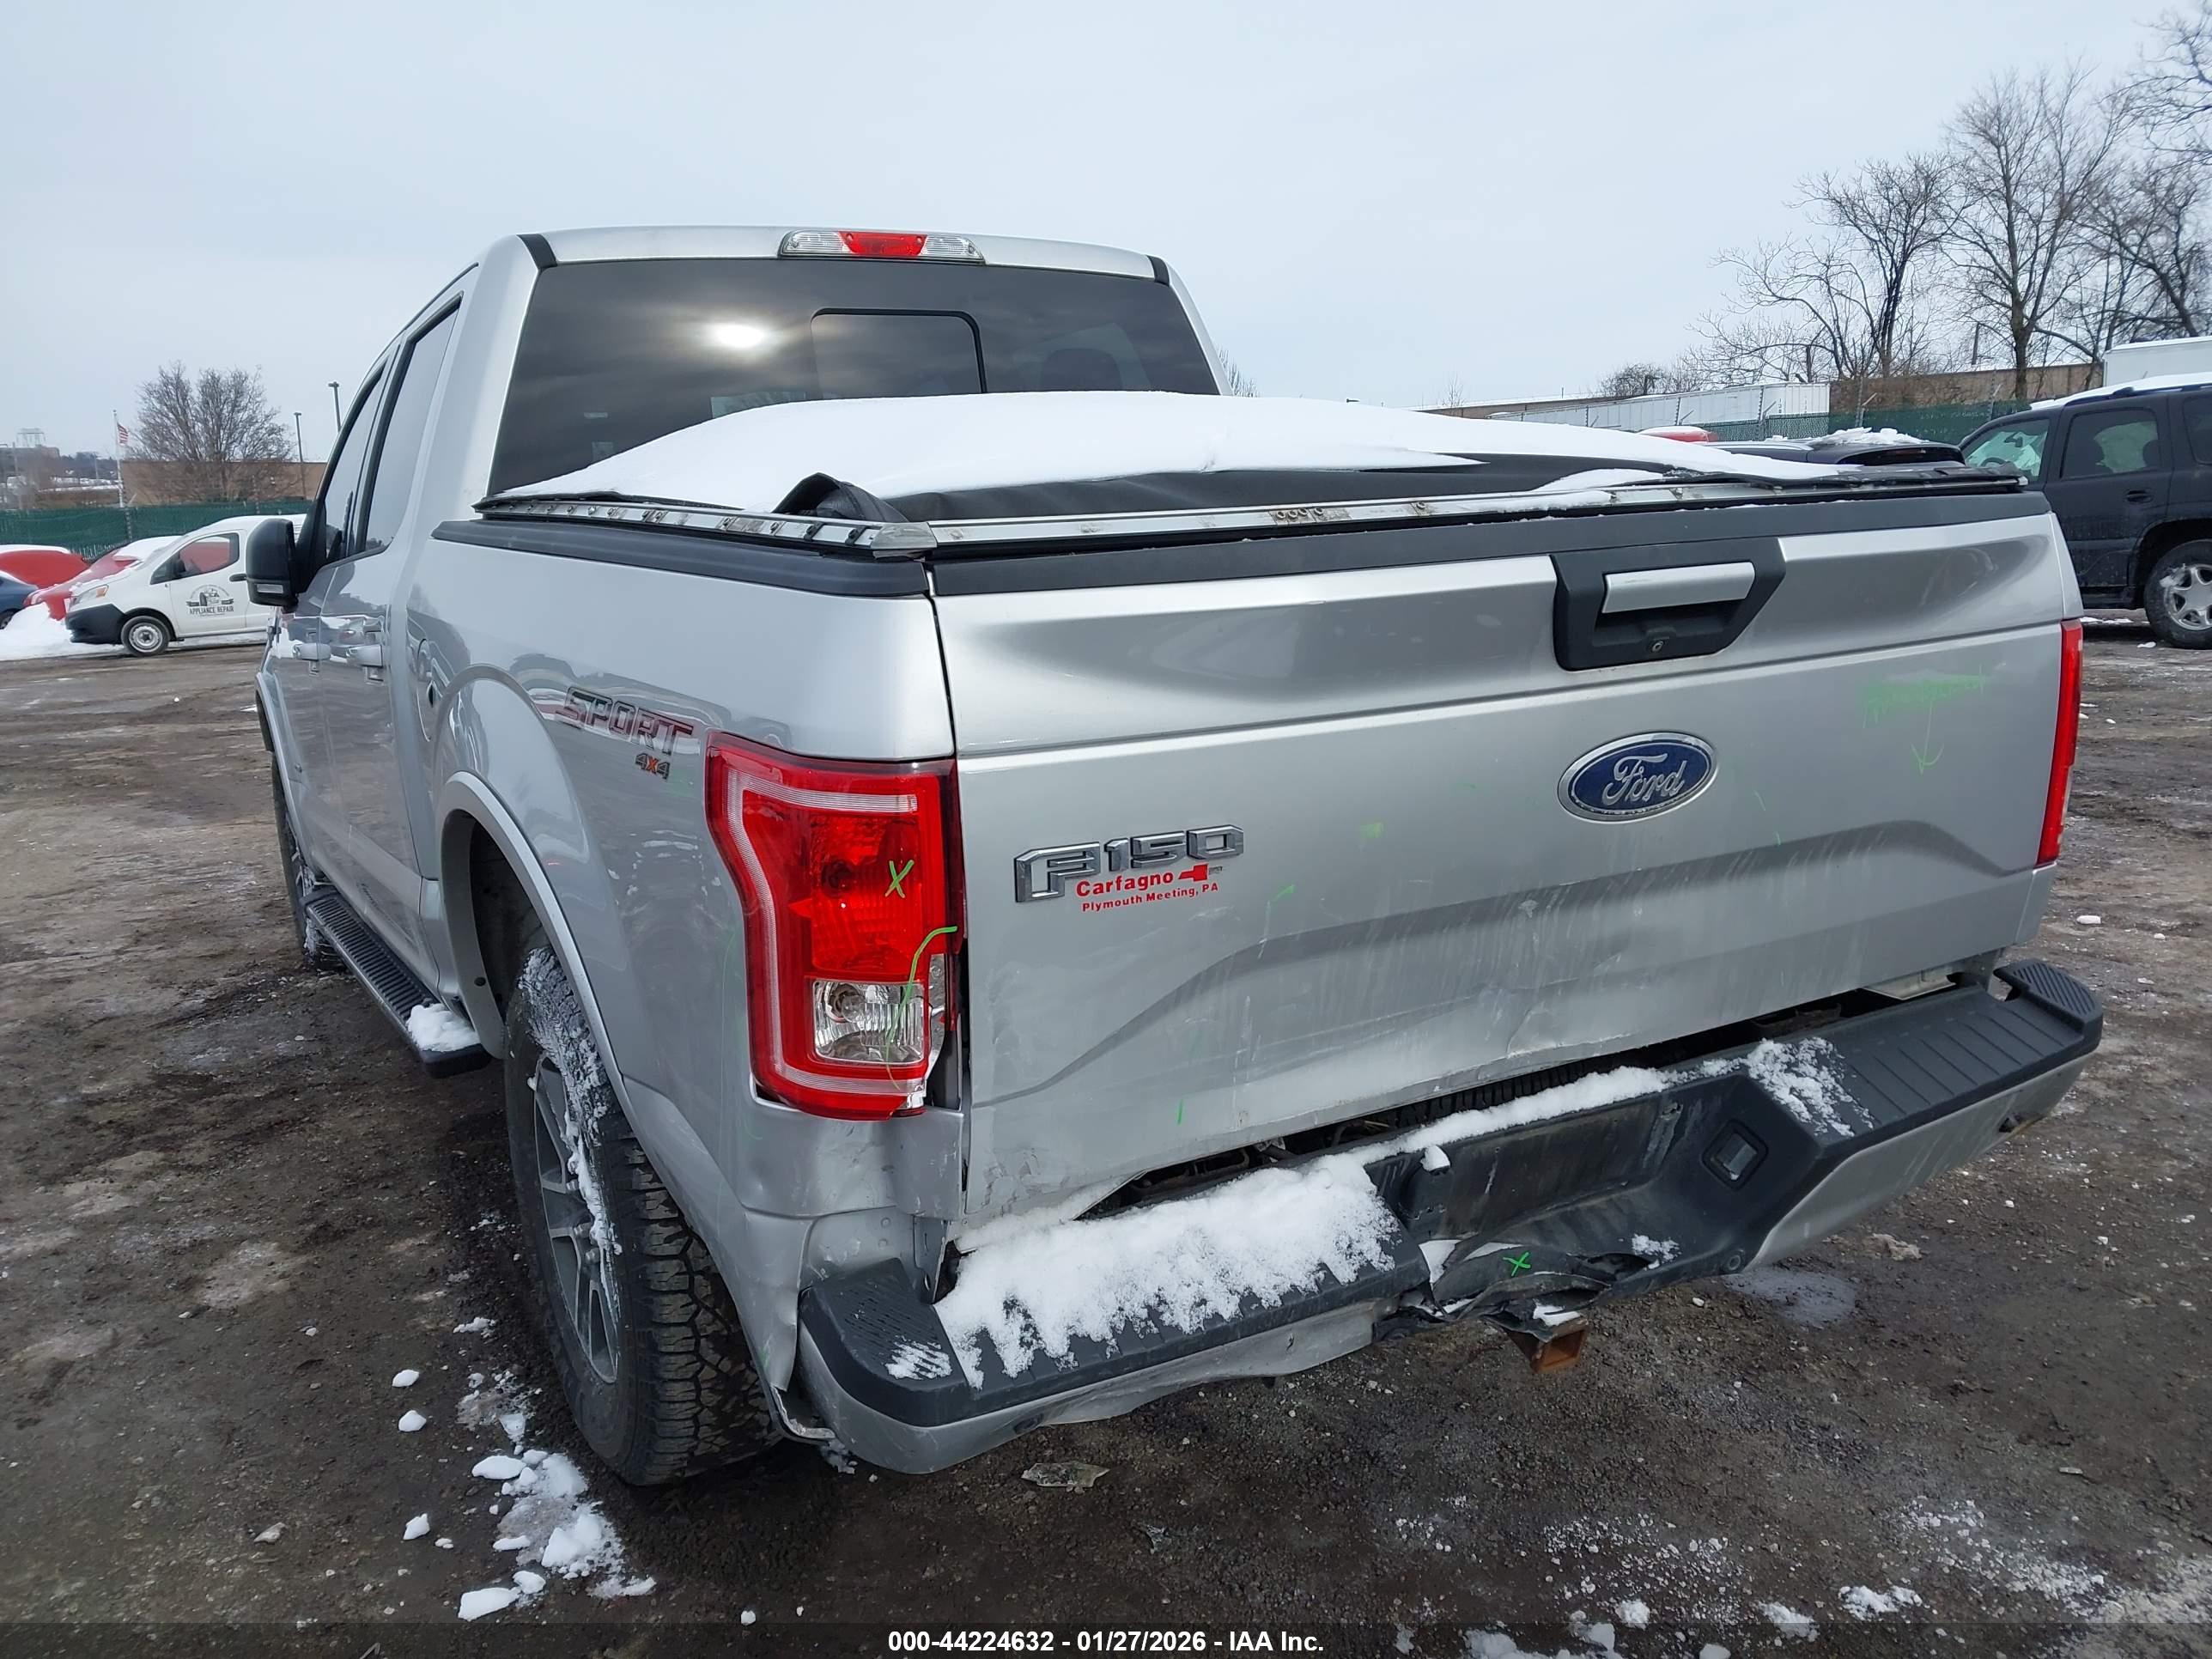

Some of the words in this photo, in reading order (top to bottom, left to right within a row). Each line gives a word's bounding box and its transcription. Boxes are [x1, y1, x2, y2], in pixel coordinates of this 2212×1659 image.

[556, 686, 694, 757] SPORT
[1602, 752, 1687, 806] Ford
[1014, 823, 1244, 903] F150
[1076, 872, 1175, 897] Carfagno
[1082, 895, 1143, 912] Plymouth
[1146, 887, 1200, 902] Meeting,
[1202, 882, 1218, 893] PA
